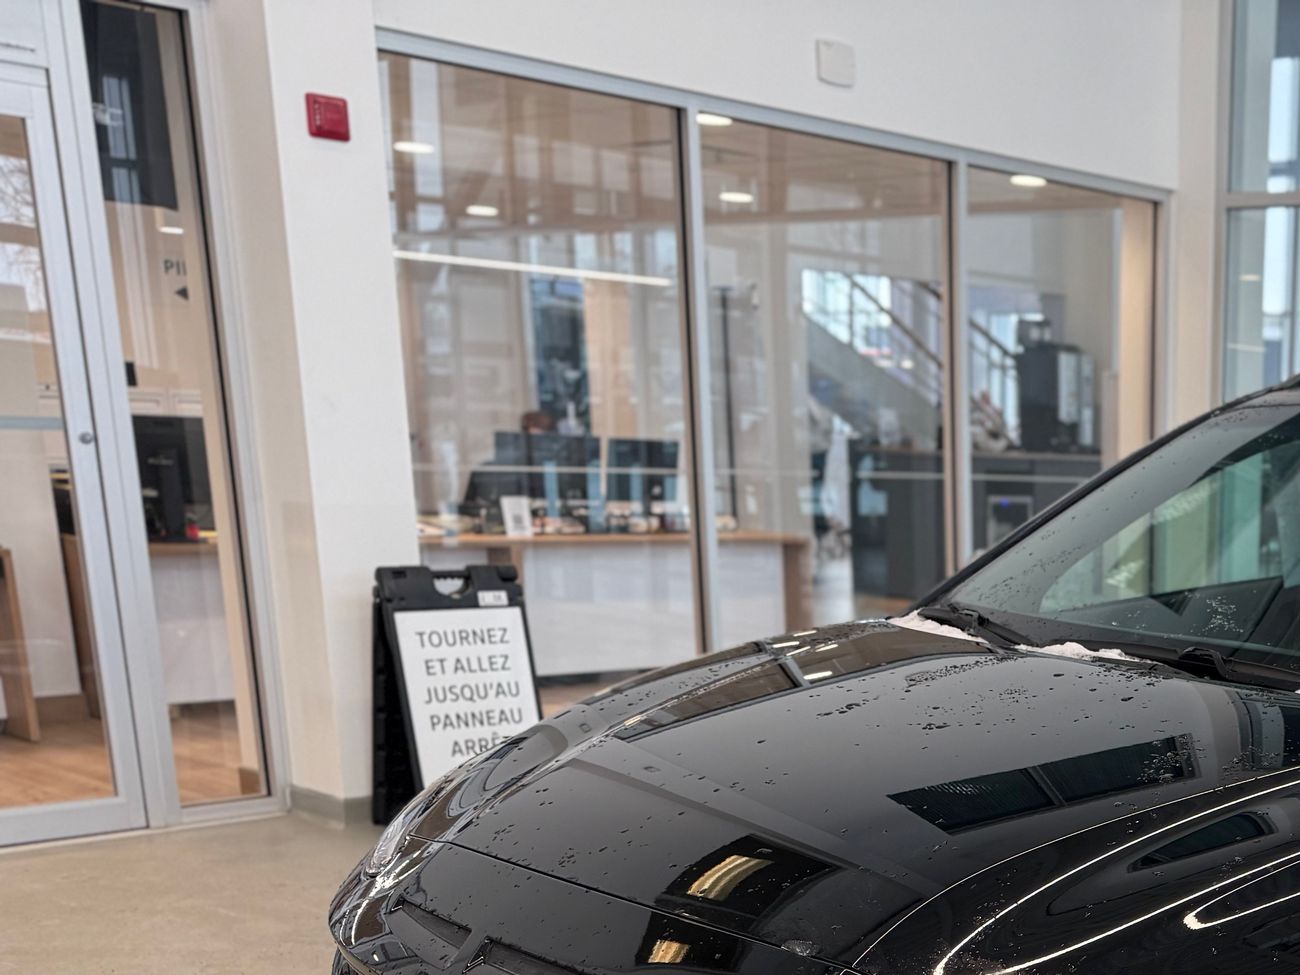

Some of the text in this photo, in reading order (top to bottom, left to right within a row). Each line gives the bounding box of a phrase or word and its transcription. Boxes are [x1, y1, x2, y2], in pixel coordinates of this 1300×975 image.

[415, 627, 510, 649] TOURNEZ
[424, 654, 511, 676] ET ALLEZ
[424, 681, 520, 705] JUSQU'AU
[429, 707, 523, 731] PANNEAU
